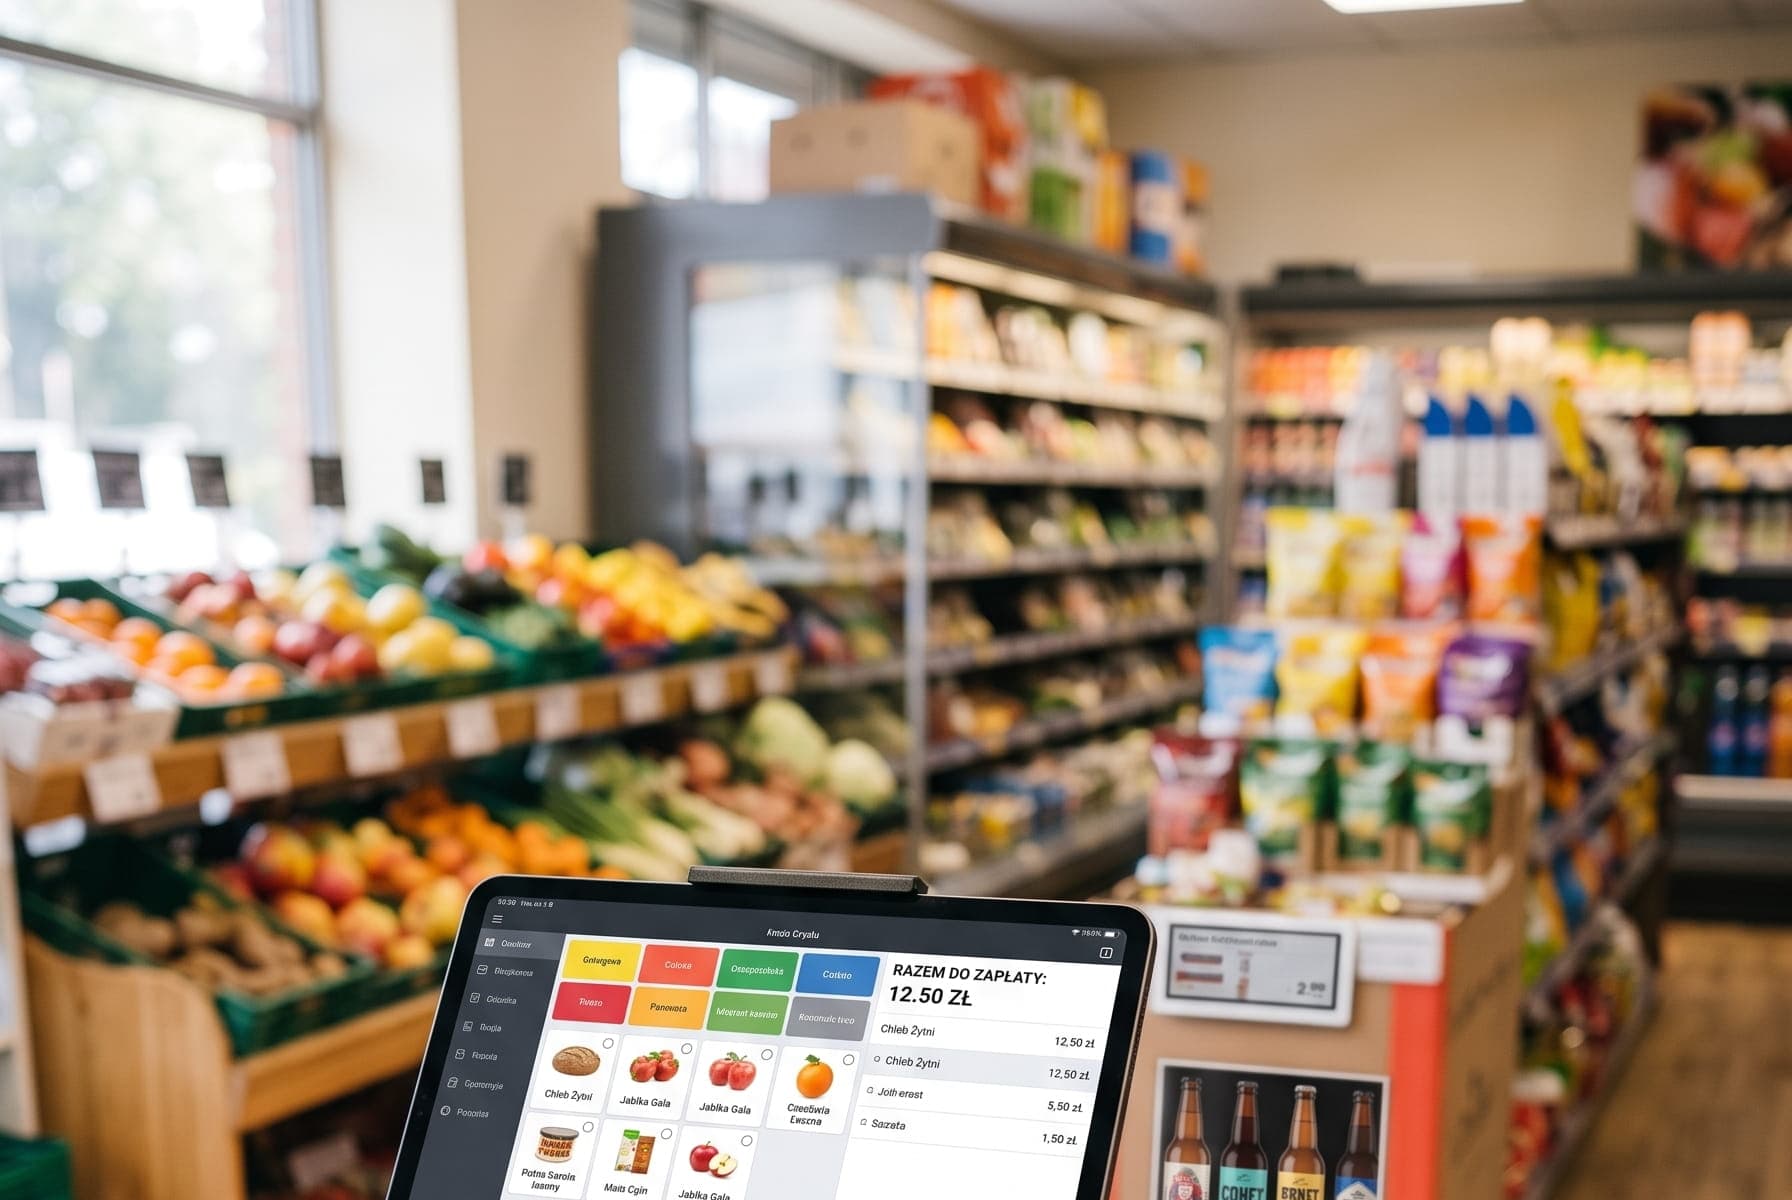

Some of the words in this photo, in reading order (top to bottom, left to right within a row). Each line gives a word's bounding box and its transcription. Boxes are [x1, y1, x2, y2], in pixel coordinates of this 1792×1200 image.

[892, 963, 946, 979] RAZEM
[948, 966, 970, 980] DO
[973, 968, 1048, 985] ZAPŁATY:
[889, 985, 944, 1004] 12.50
[947, 988, 973, 1007] ZŁ
[880, 1023, 909, 1035] Chleb
[1055, 1036, 1083, 1048] 12,50
[885, 1055, 914, 1067] Chleb
[1048, 1068, 1077, 1080] 12,50
[544, 1088, 570, 1099] Chleb
[650, 1097, 672, 1108] Gala
[1047, 1100, 1070, 1112] 5,50
[731, 1104, 751, 1115] Gala
[1042, 1133, 1065, 1145] 1,50
